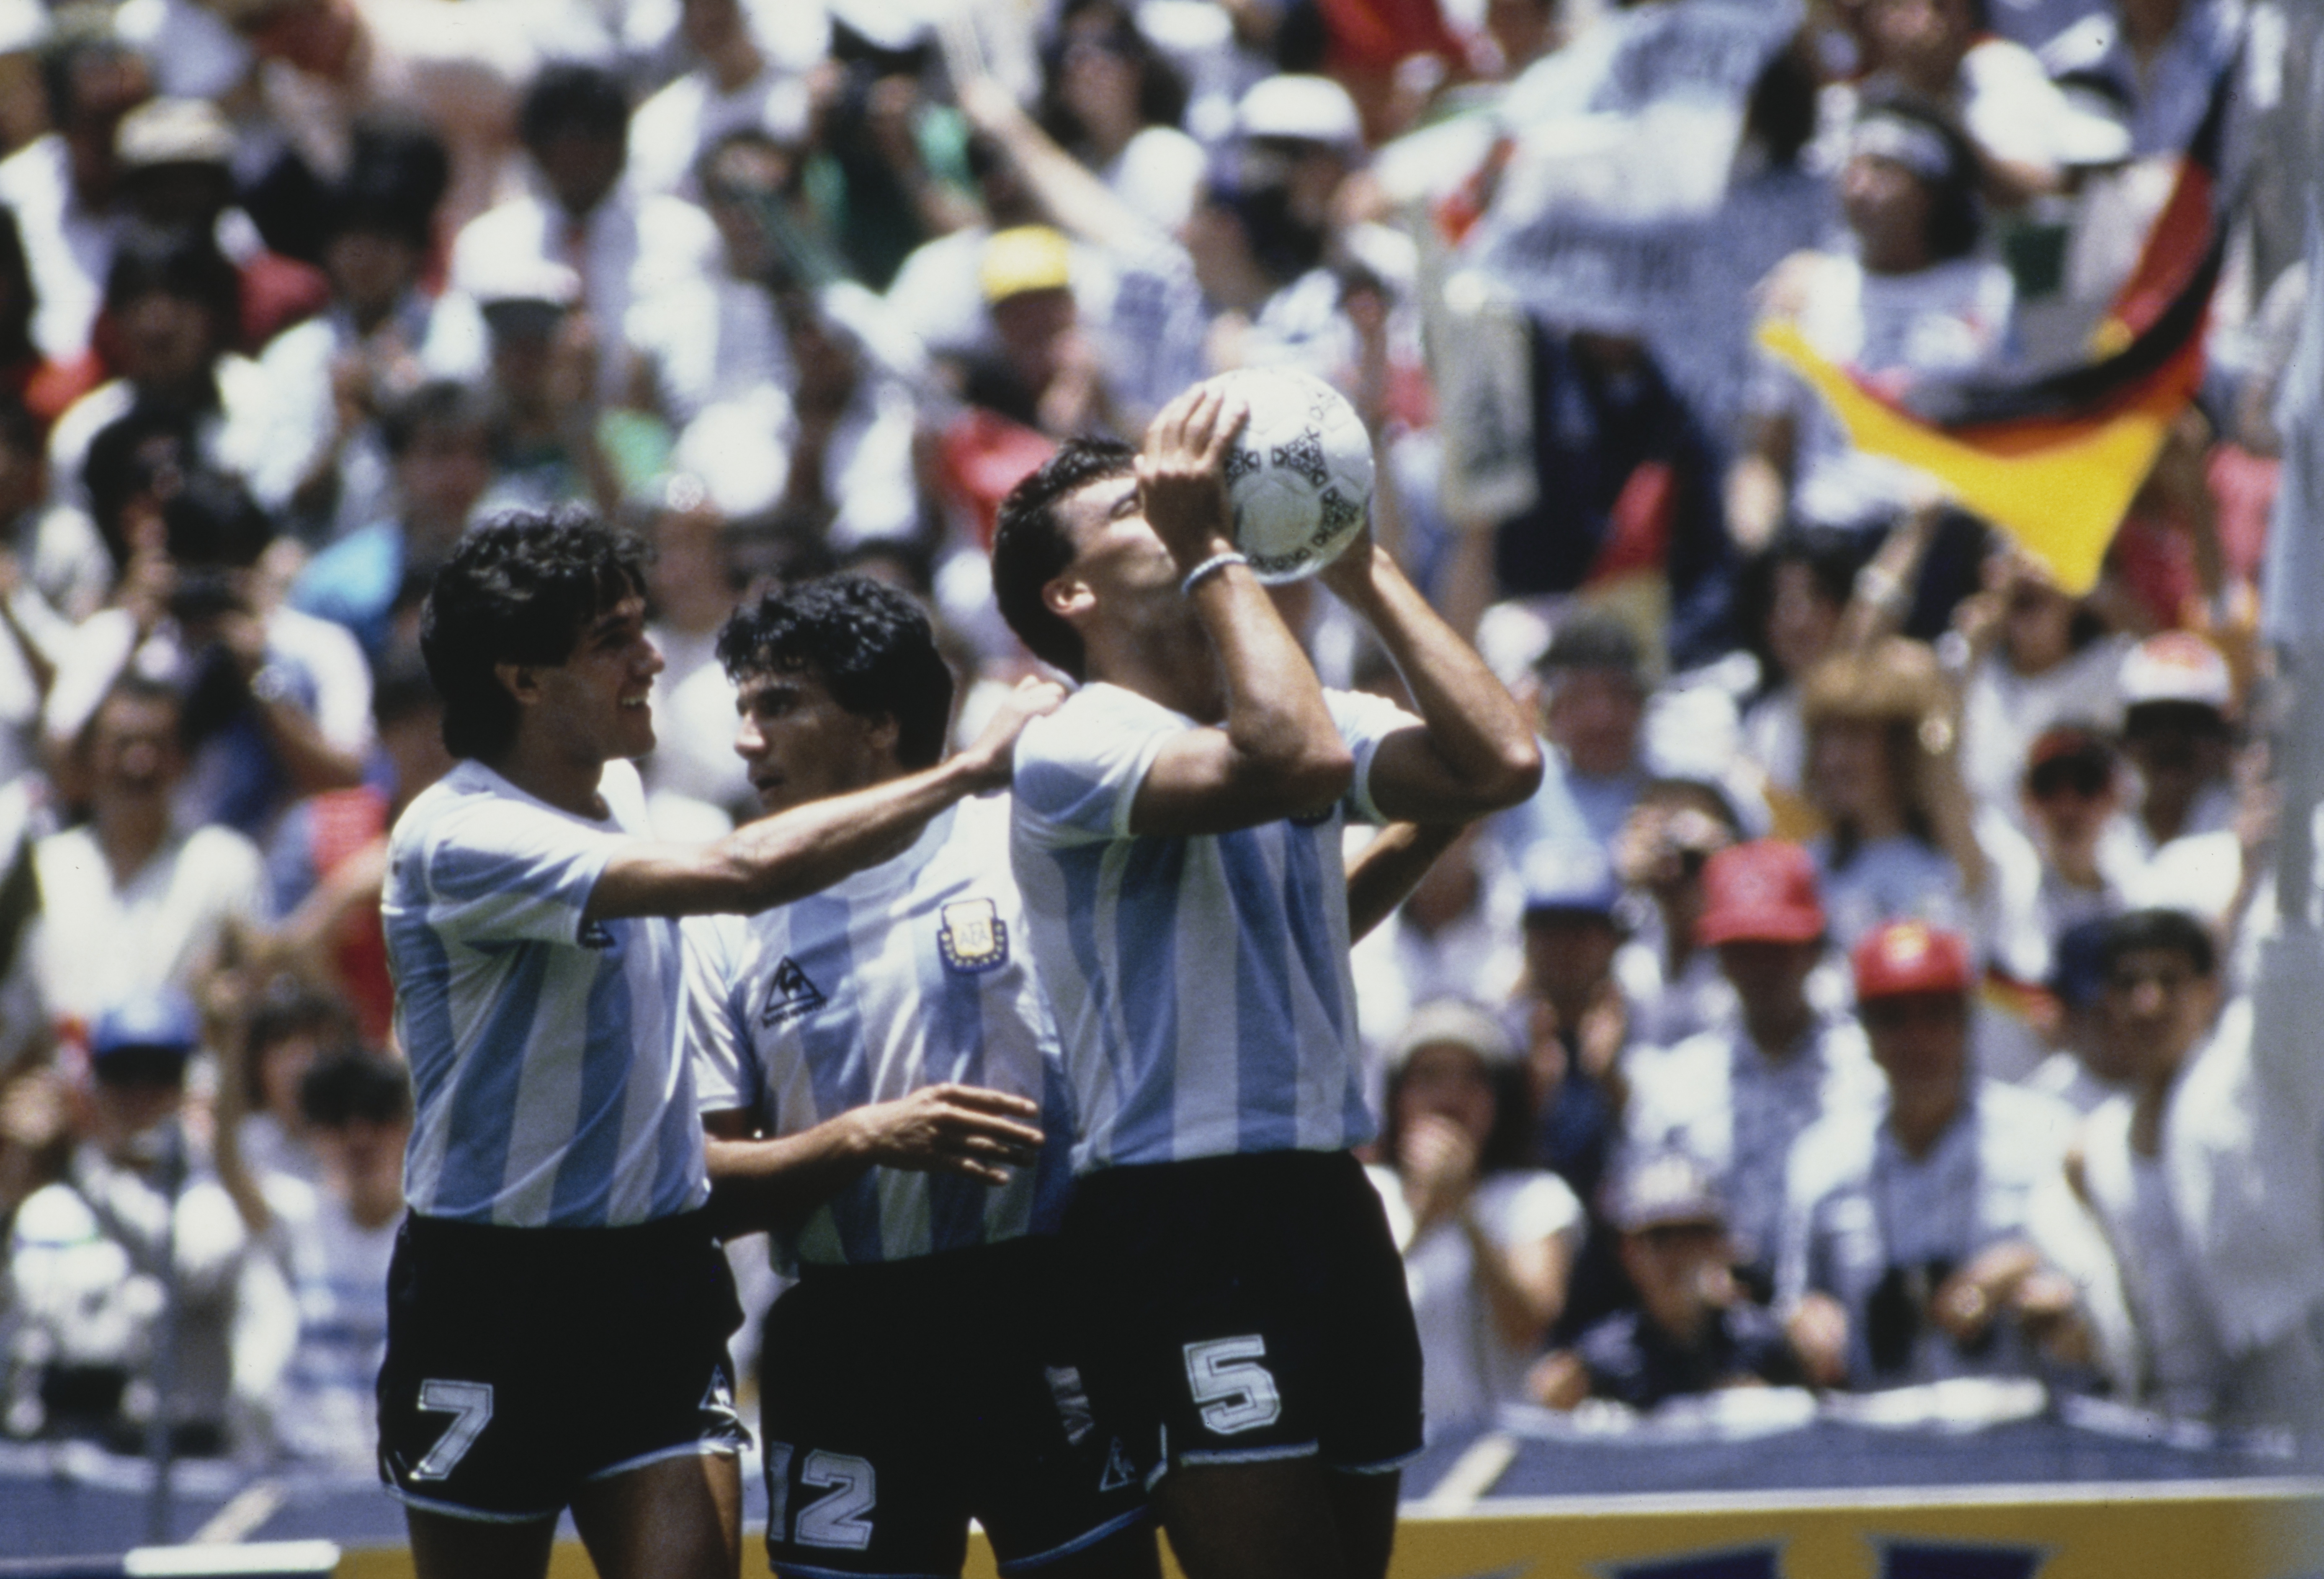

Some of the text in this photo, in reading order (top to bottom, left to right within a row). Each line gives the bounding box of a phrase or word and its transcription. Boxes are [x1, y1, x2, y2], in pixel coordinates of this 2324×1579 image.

[409, 1378, 493, 1481] 7
[1183, 1334, 1281, 1435] 5
[770, 1440, 876, 1551] 12
